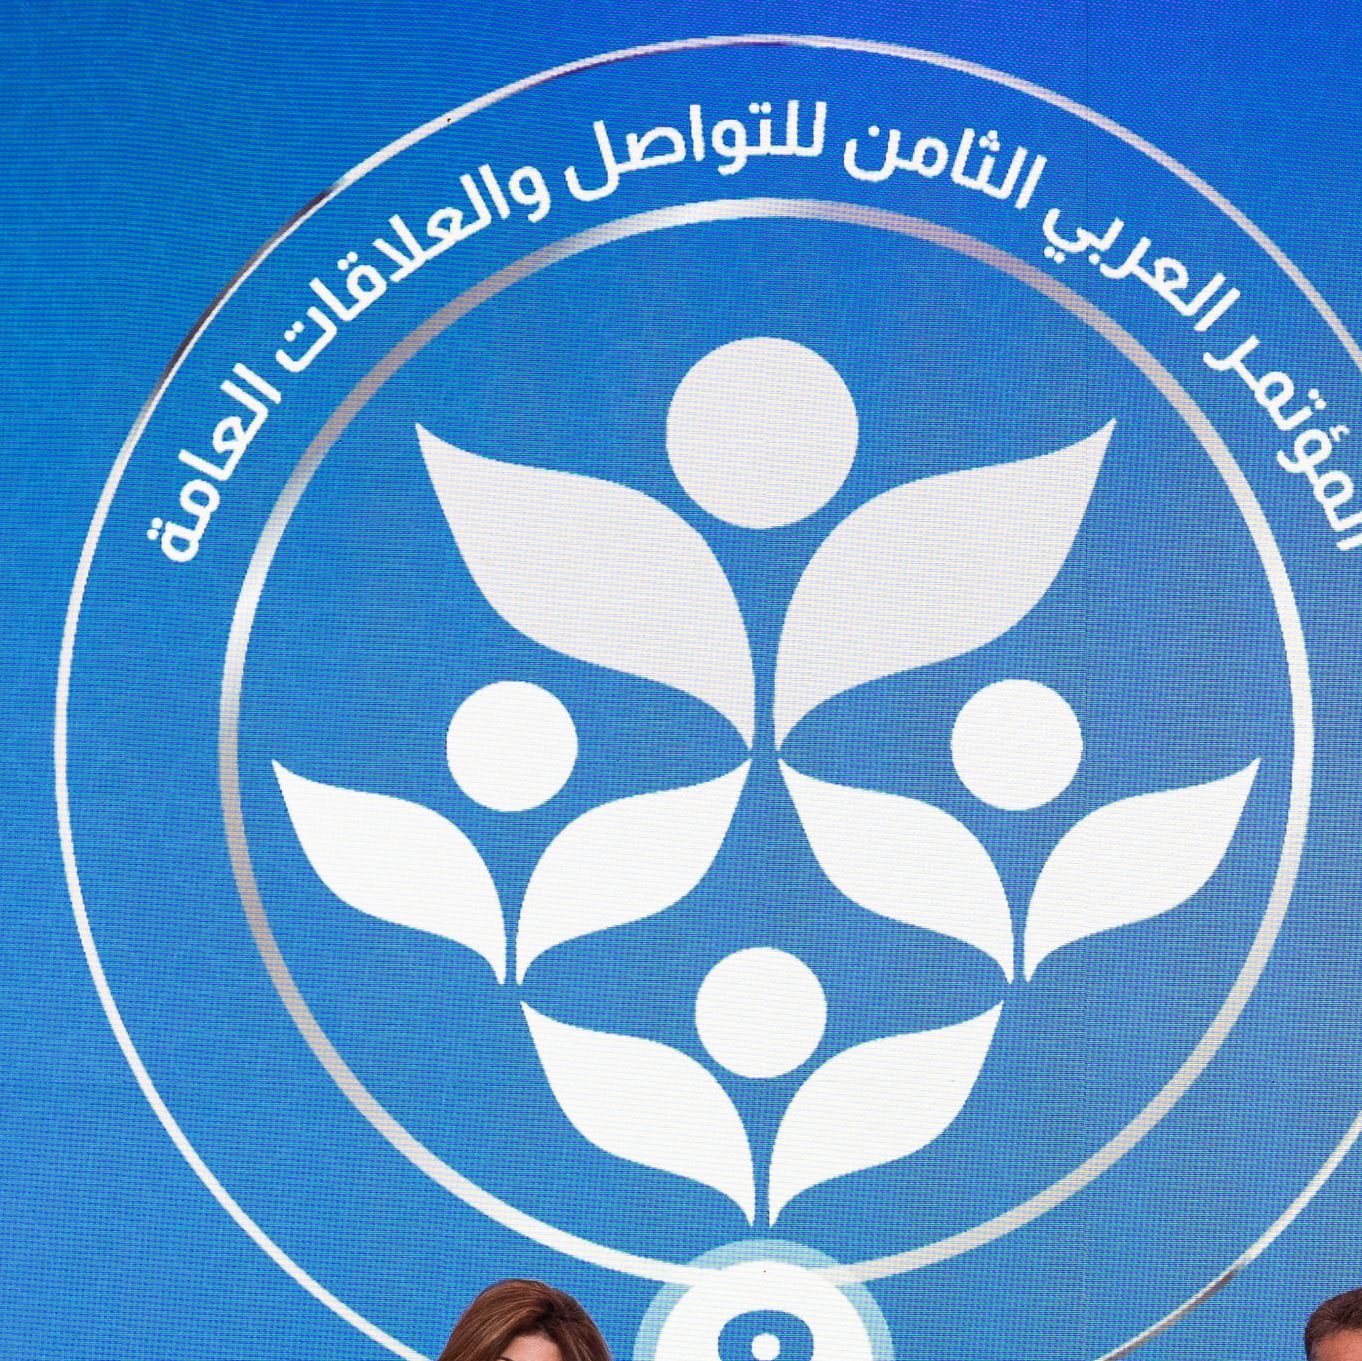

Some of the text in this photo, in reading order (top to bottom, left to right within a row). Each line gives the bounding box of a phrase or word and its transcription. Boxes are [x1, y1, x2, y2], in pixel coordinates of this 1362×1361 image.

[563, 98, 828, 206] للتواصل
[842, 124, 1049, 211] الثامن
[274, 162, 552, 373] والعلاقات
[1041, 206, 1241, 333] العربي
[145, 361, 283, 563] العامة
